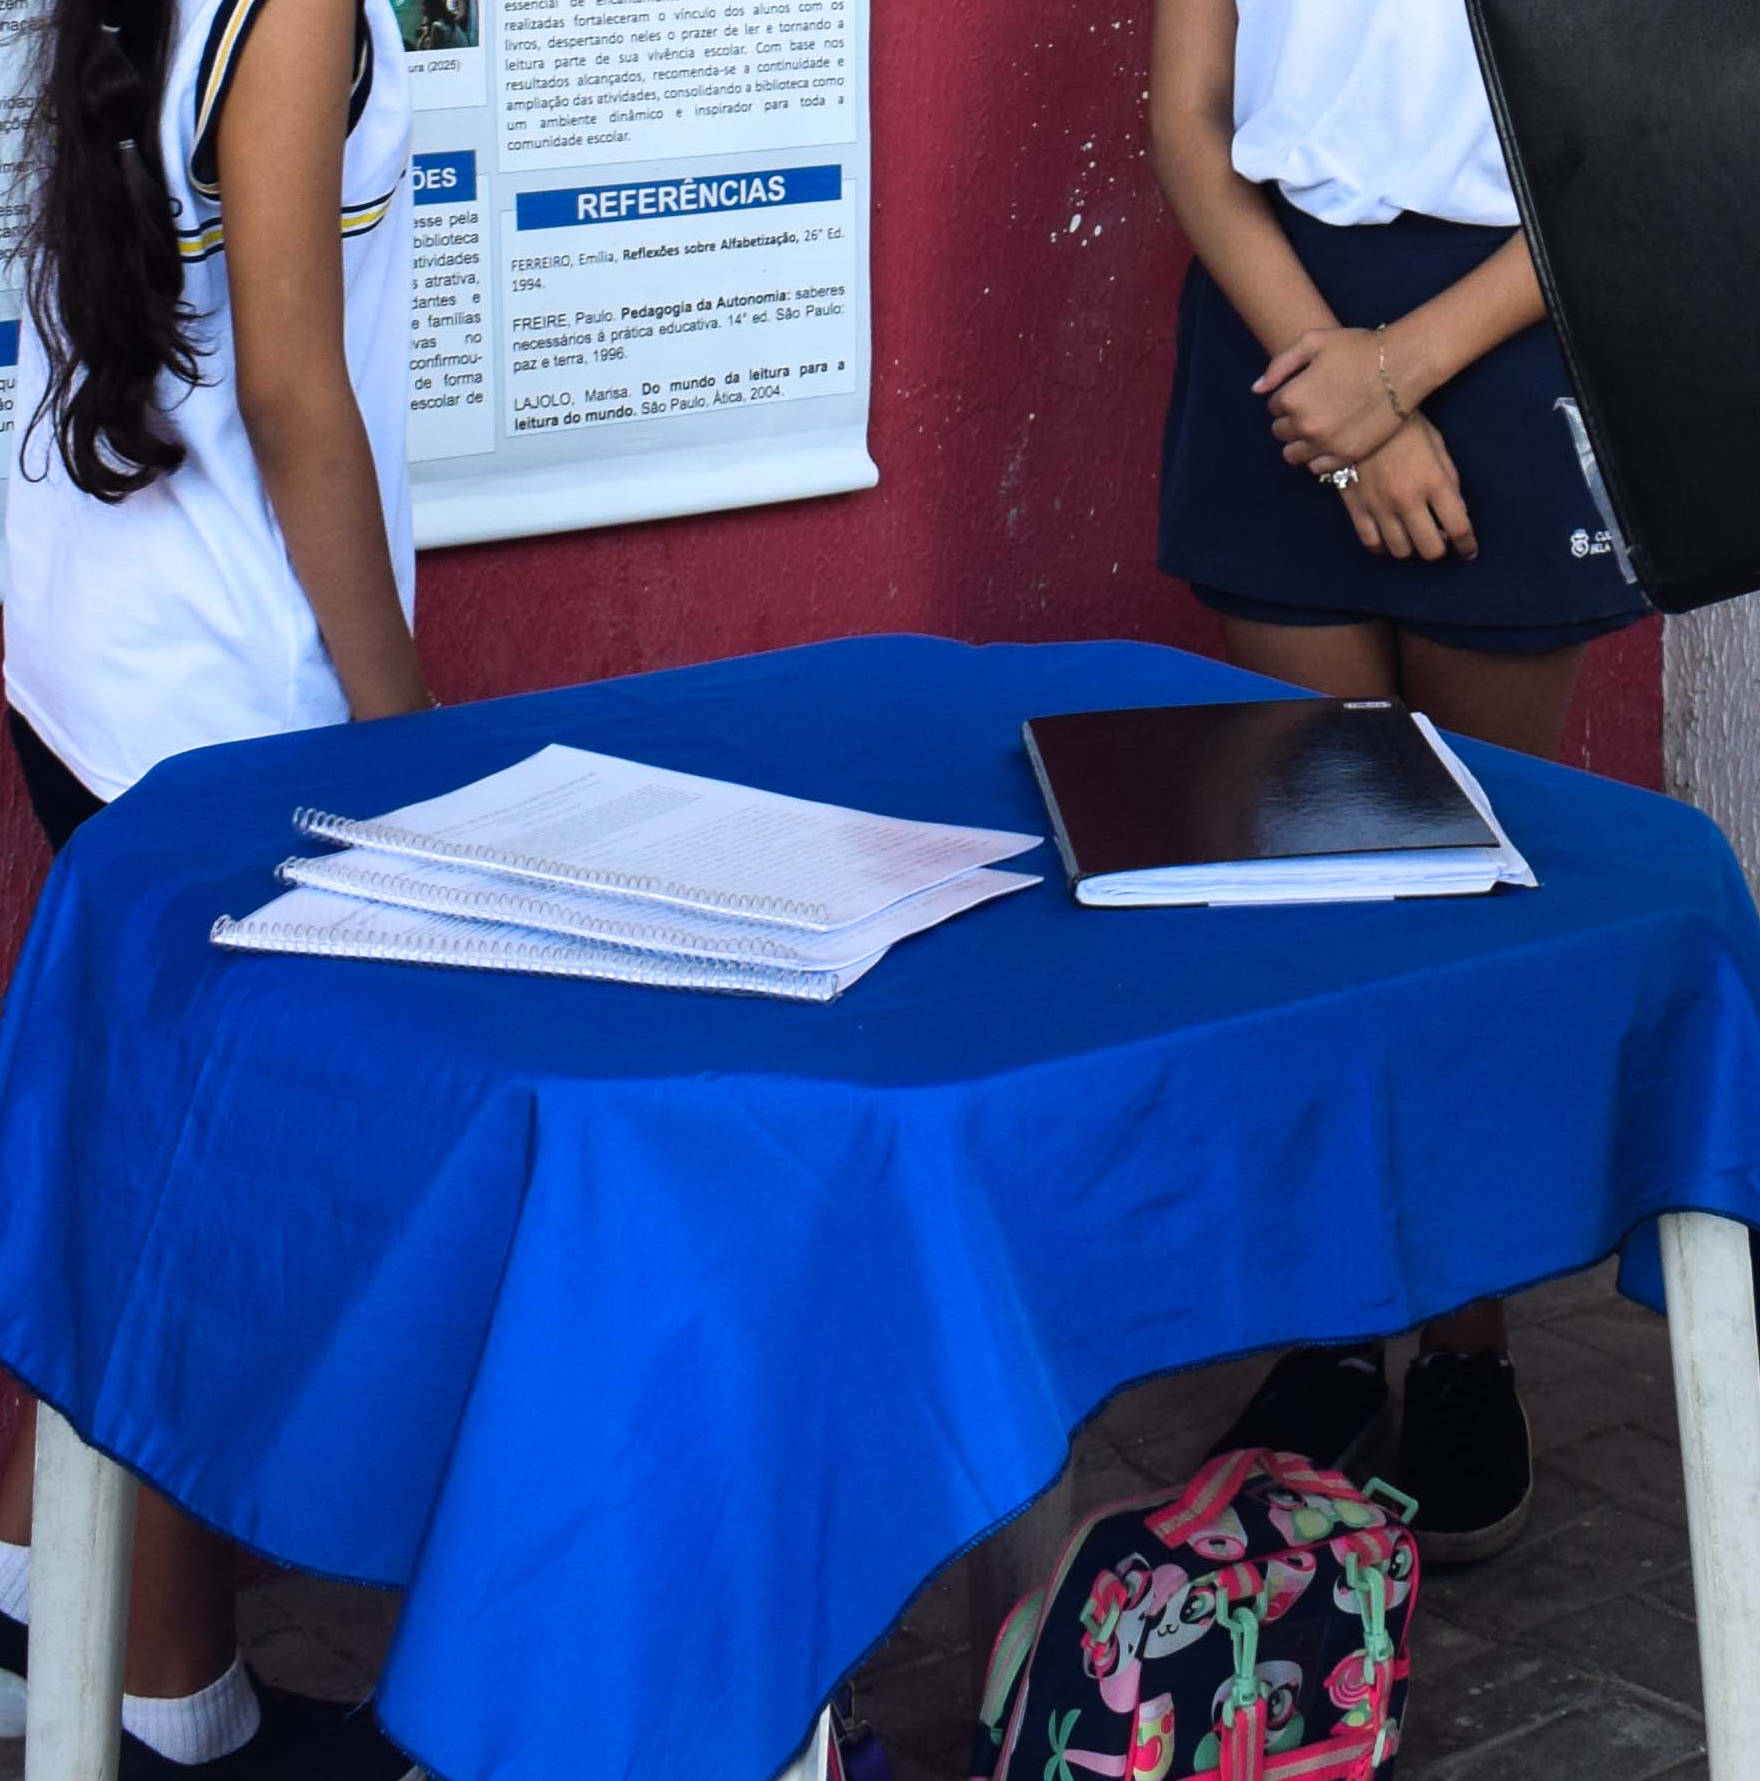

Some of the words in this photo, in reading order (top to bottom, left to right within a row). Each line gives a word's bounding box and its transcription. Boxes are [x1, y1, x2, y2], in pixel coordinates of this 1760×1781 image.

[506, 133, 583, 151] comunidade
[586, 130, 630, 145] escolar.
[577, 175, 785, 220] REFERÊNCIAS
[424, 273, 480, 288] atrativa,
[621, 300, 692, 320] Pedagogia
[696, 298, 712, 312] da
[715, 289, 791, 309] Autonomia:
[795, 285, 845, 300] saberes
[427, 311, 481, 328] famílias
[514, 415, 559, 431] leitura
[562, 411, 582, 425] do
[641, 401, 667, 415] São
[670, 395, 709, 410] Paulo,
[750, 384, 784, 400] 2004.
